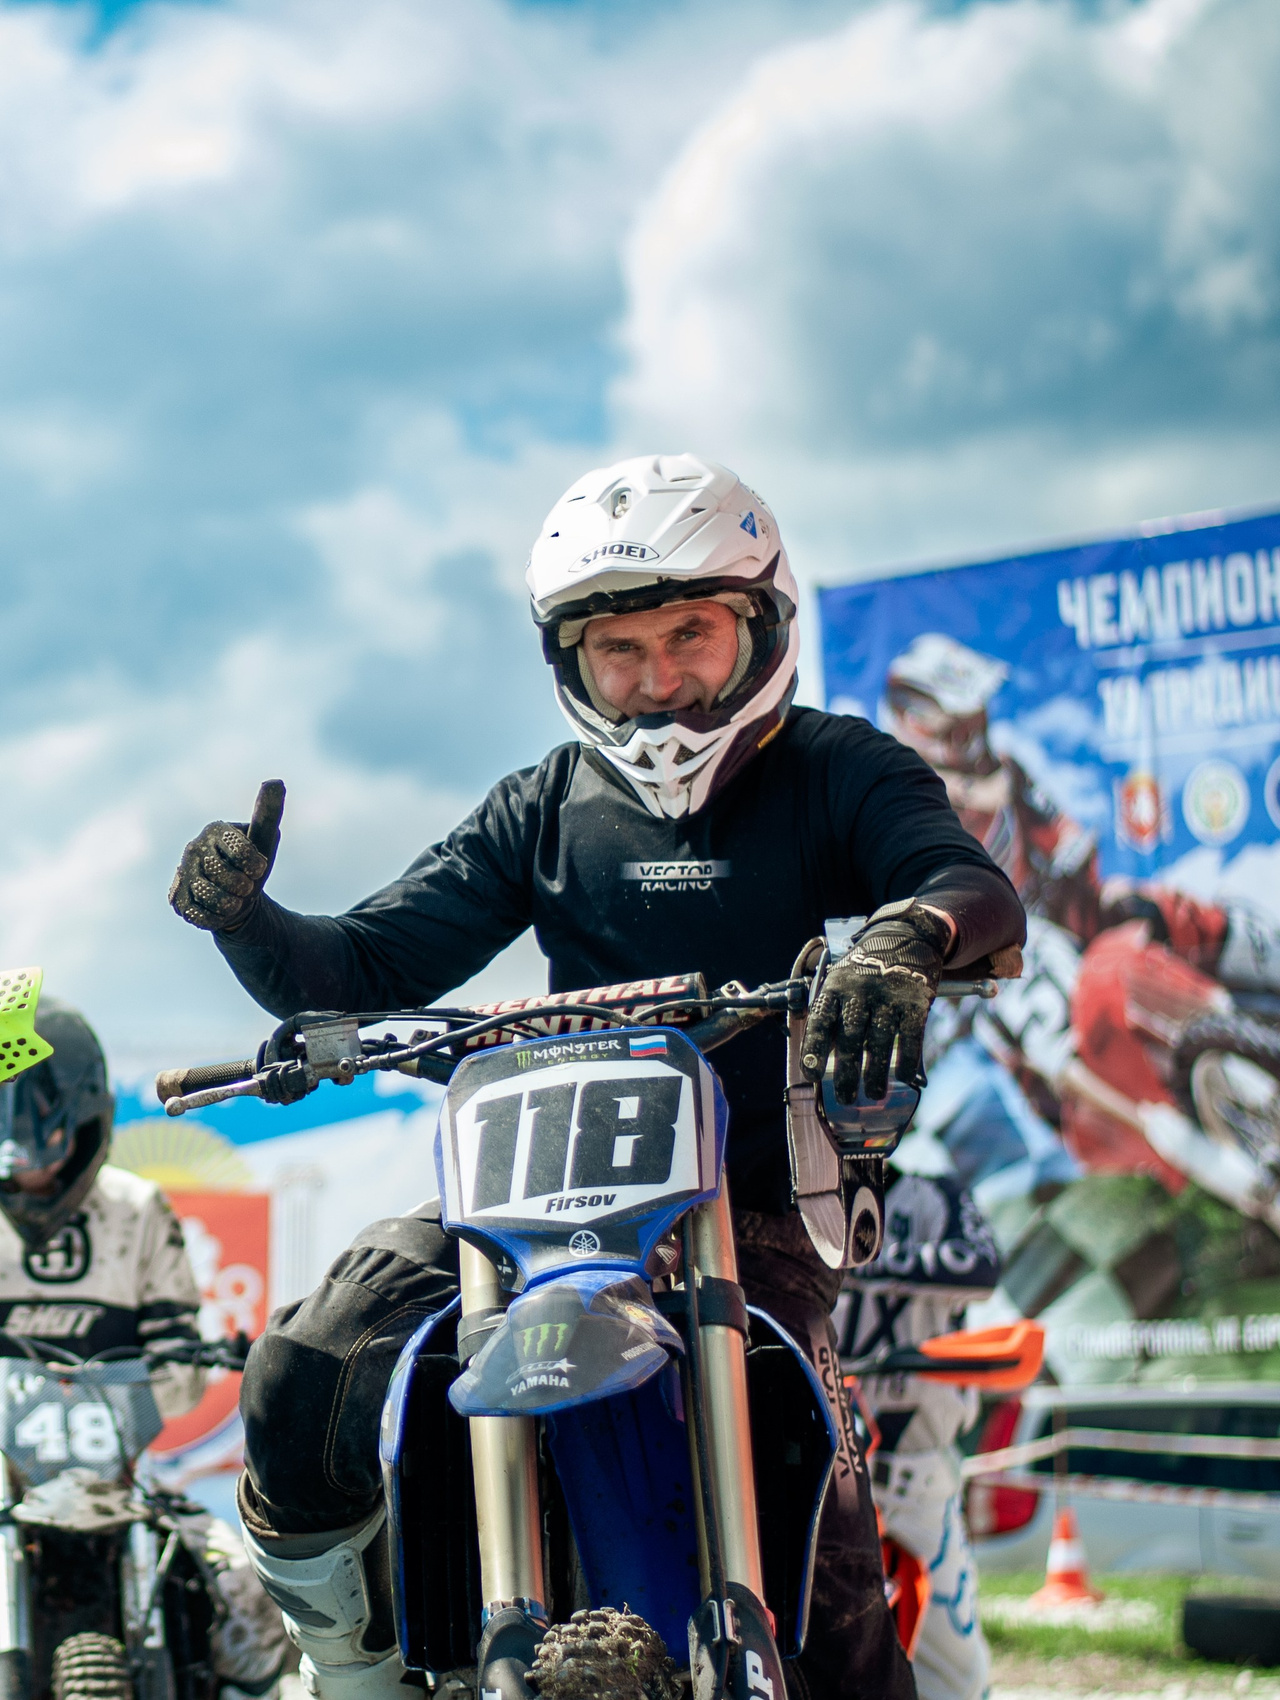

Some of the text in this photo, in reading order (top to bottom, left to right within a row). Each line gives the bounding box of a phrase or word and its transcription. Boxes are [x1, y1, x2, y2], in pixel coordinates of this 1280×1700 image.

[580, 544, 647, 568] SHOEI
[639, 864, 713, 876] VECTOR
[640, 880, 712, 892] RACING
[547, 1053, 609, 1066] ENERGY
[471, 1076, 683, 1214] 118
[843, 1152, 885, 1160] OAKLEY
[544, 1193, 617, 1214] Firsov
[4, 1303, 106, 1338] SHOT
[510, 1374, 570, 1396] YAMAHA
[15, 1401, 120, 1463] 48
